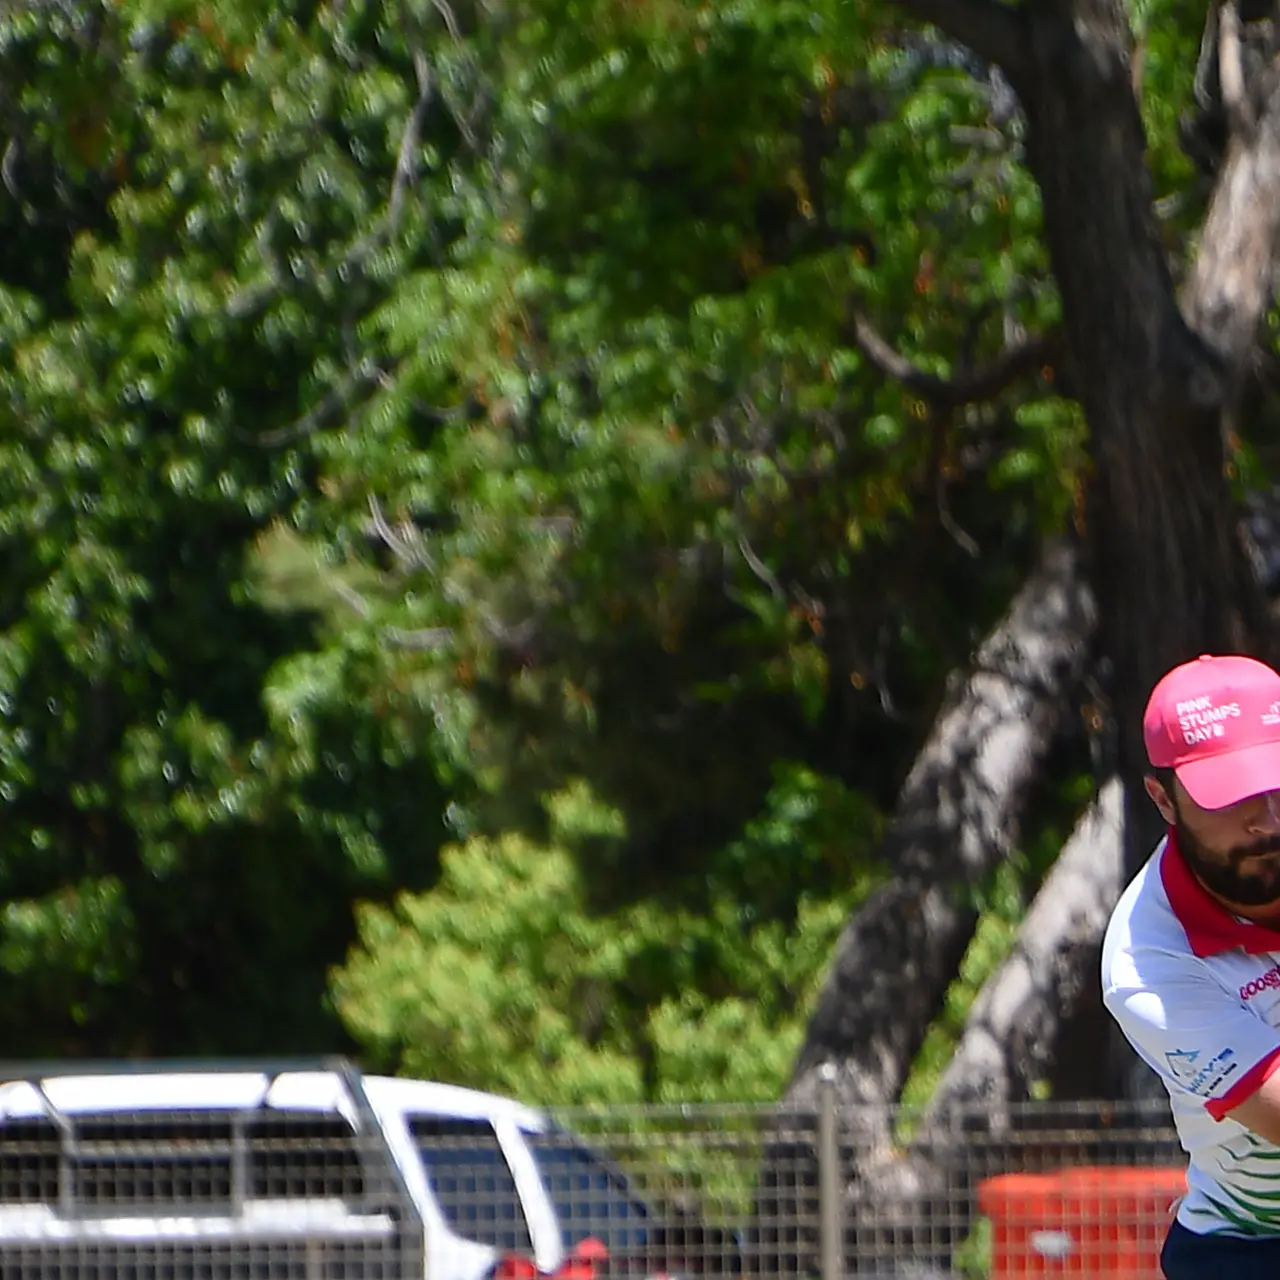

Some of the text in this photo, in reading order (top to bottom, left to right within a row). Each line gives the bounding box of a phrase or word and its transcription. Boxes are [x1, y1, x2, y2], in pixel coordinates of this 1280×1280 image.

[1176, 696, 1212, 715] PINK
[1179, 702, 1241, 730] STUMPS
[1183, 725, 1212, 745] DAY
